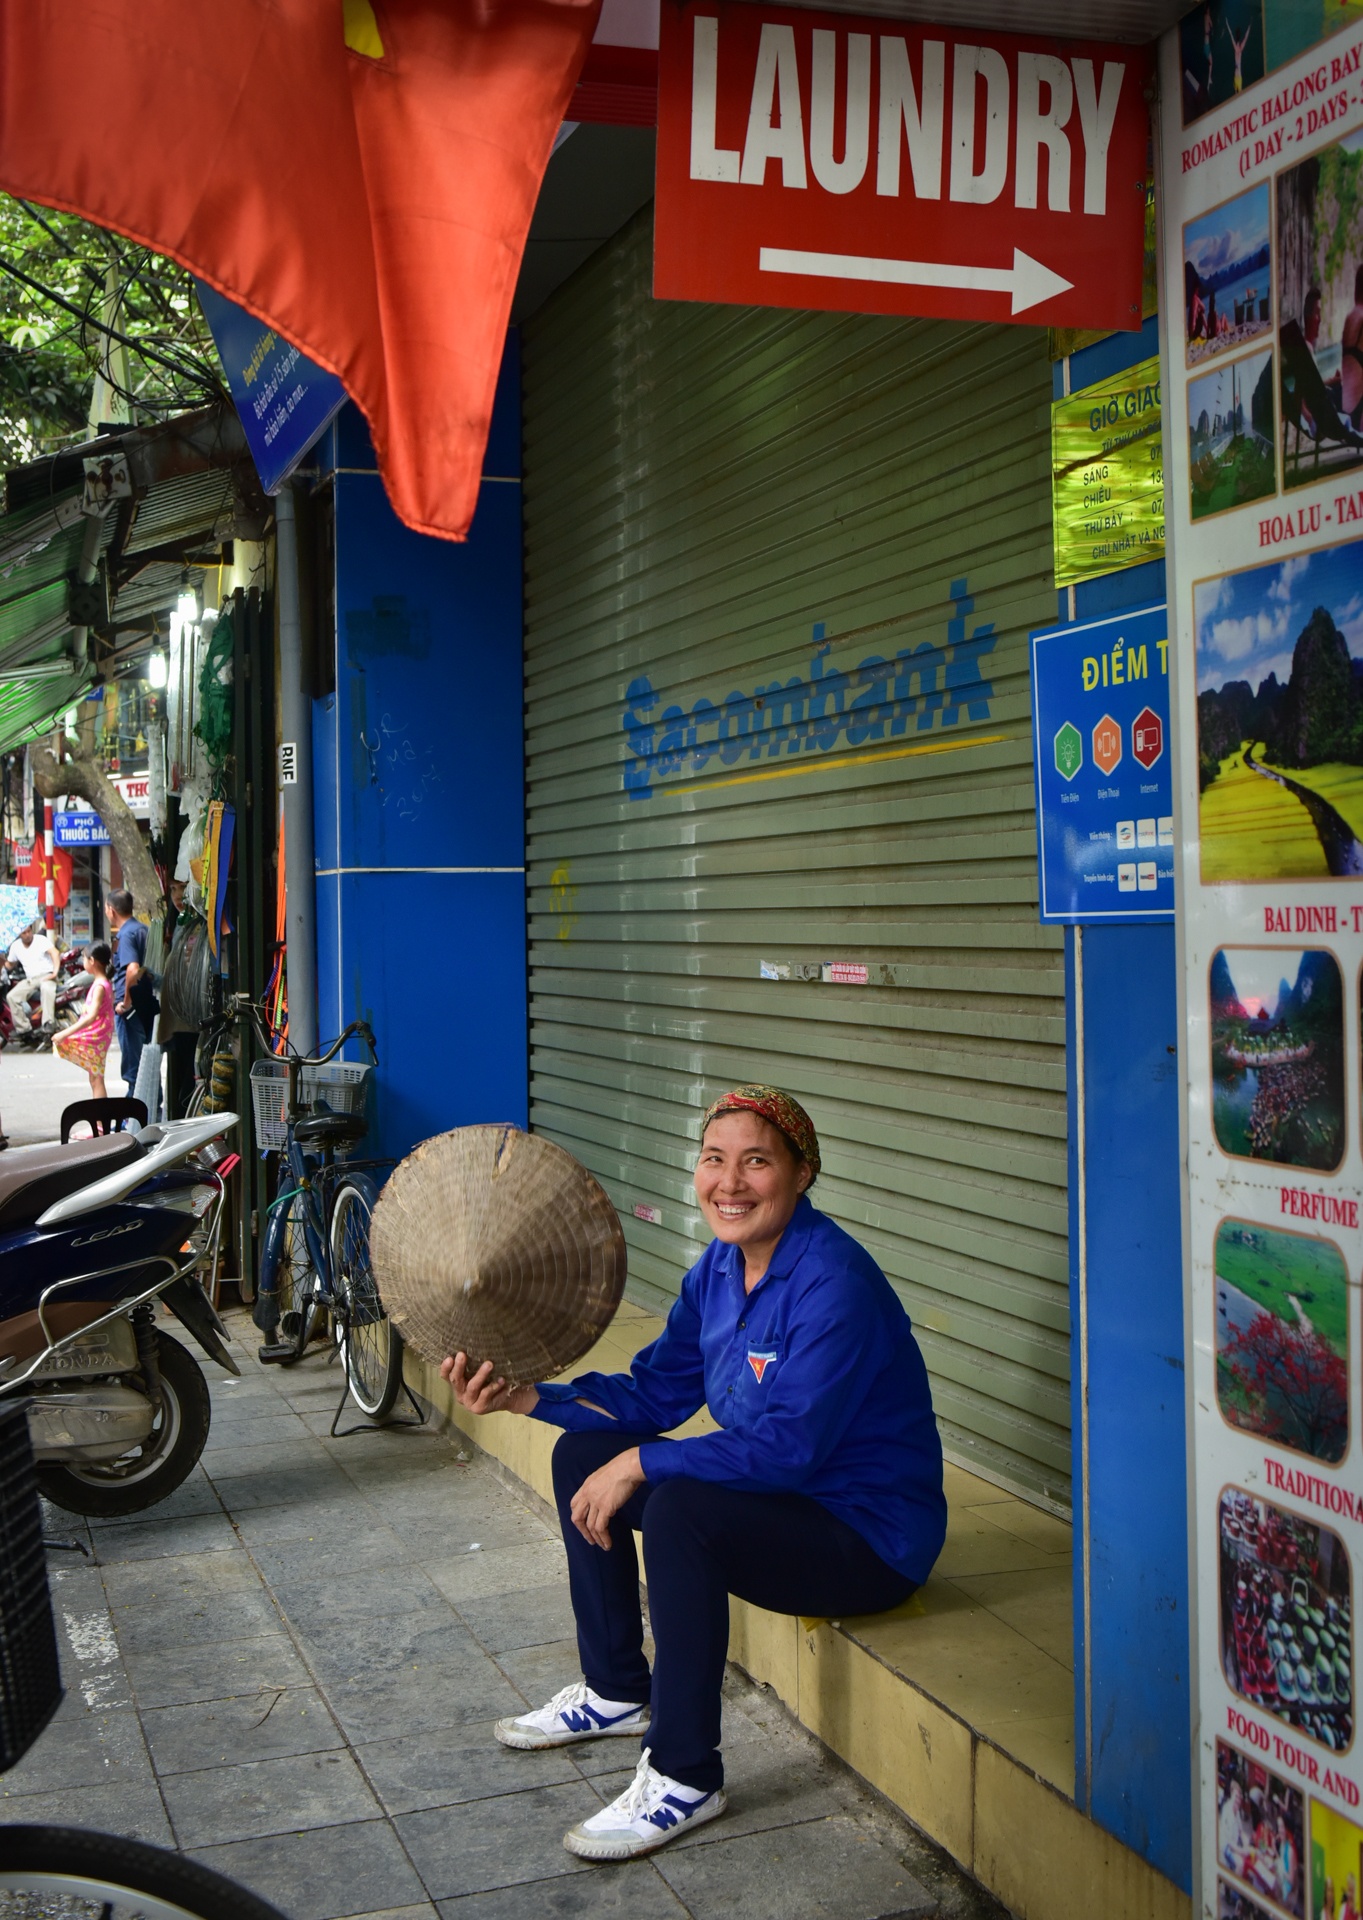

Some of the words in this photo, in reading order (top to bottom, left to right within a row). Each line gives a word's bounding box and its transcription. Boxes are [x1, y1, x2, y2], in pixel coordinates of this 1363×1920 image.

[689, 15, 1126, 215] LAUNDRY
[1181, 107, 1258, 175] ROMANTIC
[1261, 65, 1327, 127] HALONG
[1330, 41, 1363, 85] BAY
[1238, 147, 1250, 178] (1
[1254, 126, 1285, 166] DAY
[1295, 117, 1303, 142] 2
[1307, 89, 1348, 136] DAYS
[1090, 395, 1119, 432] GIỜ
[1083, 466, 1109, 486] SÁNG
[1083, 485, 1111, 508] CHIỀU
[1085, 516, 1103, 536] THỨ
[1105, 510, 1123, 530] BẢY
[1258, 513, 1295, 547] HOA
[1298, 503, 1322, 536] LU
[1092, 539, 1110, 559] CHỦ
[1113, 534, 1136, 553] NHẬT
[1139, 528, 1150, 545] VÀ
[1082, 637, 1148, 692] ĐIỂM
[622, 577, 998, 801] Sacombank
[1140, 783, 1158, 794] Internet
[60, 826, 90, 841] THUỐC
[74, 815, 94, 826] PHỐ
[1264, 905, 1292, 932] BAI
[1294, 905, 1338, 932] DINH
[1280, 1186, 1359, 1229] PERFUME
[40, 1351, 114, 1372] HONDA
[1226, 1705, 1270, 1752] FOOD
[1273, 1734, 1319, 1785] TOUR
[1322, 1766, 1360, 1806] AND
